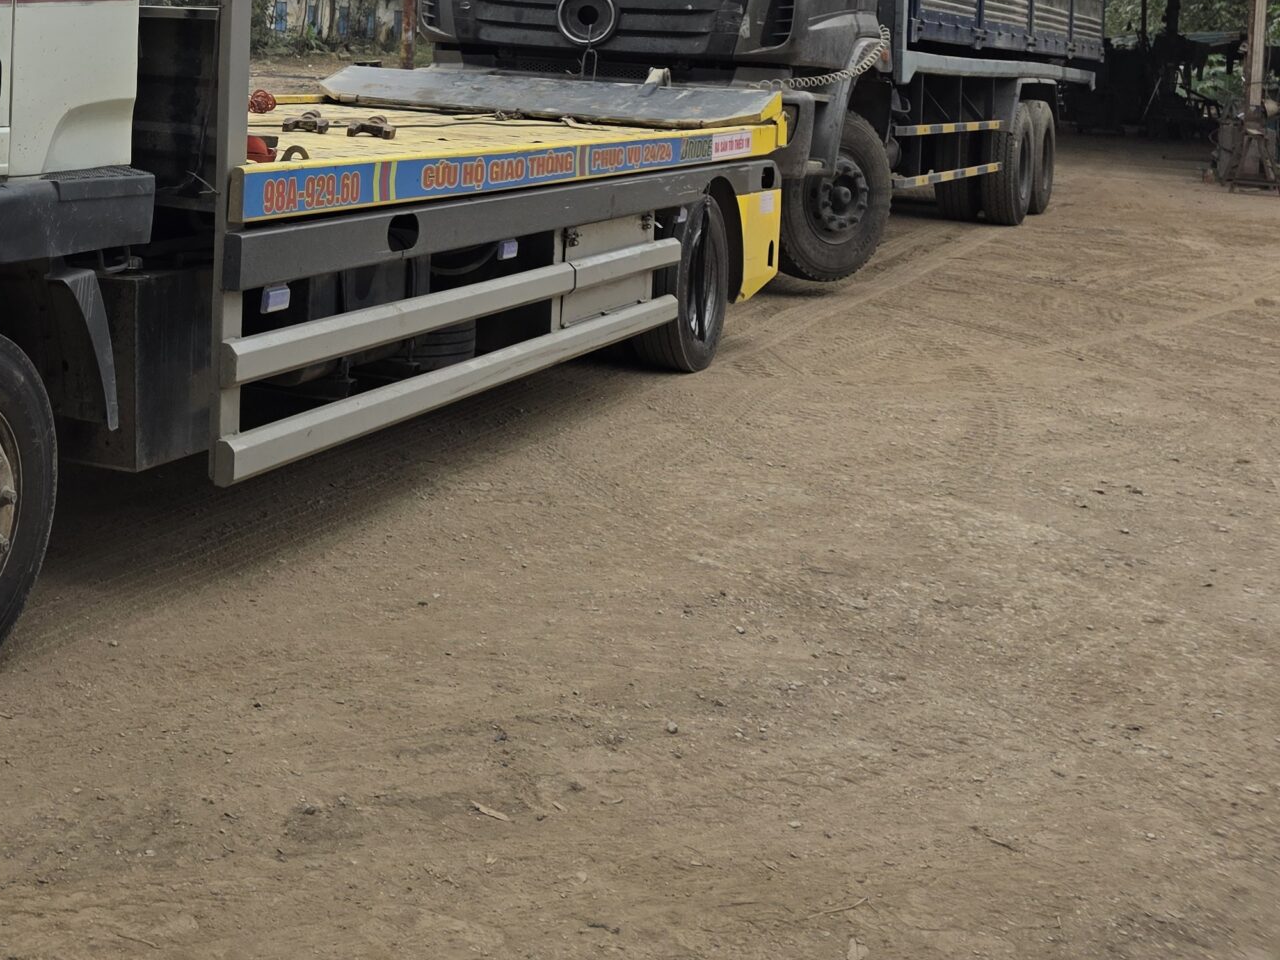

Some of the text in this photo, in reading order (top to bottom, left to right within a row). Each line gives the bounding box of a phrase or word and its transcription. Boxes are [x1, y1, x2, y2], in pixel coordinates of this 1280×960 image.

[421, 150, 575, 191] CỨU HỘ GIAO THÔNG
[591, 142, 673, 172] PHỤC VỤ 24/24
[263, 171, 361, 214] 98A-929.60
